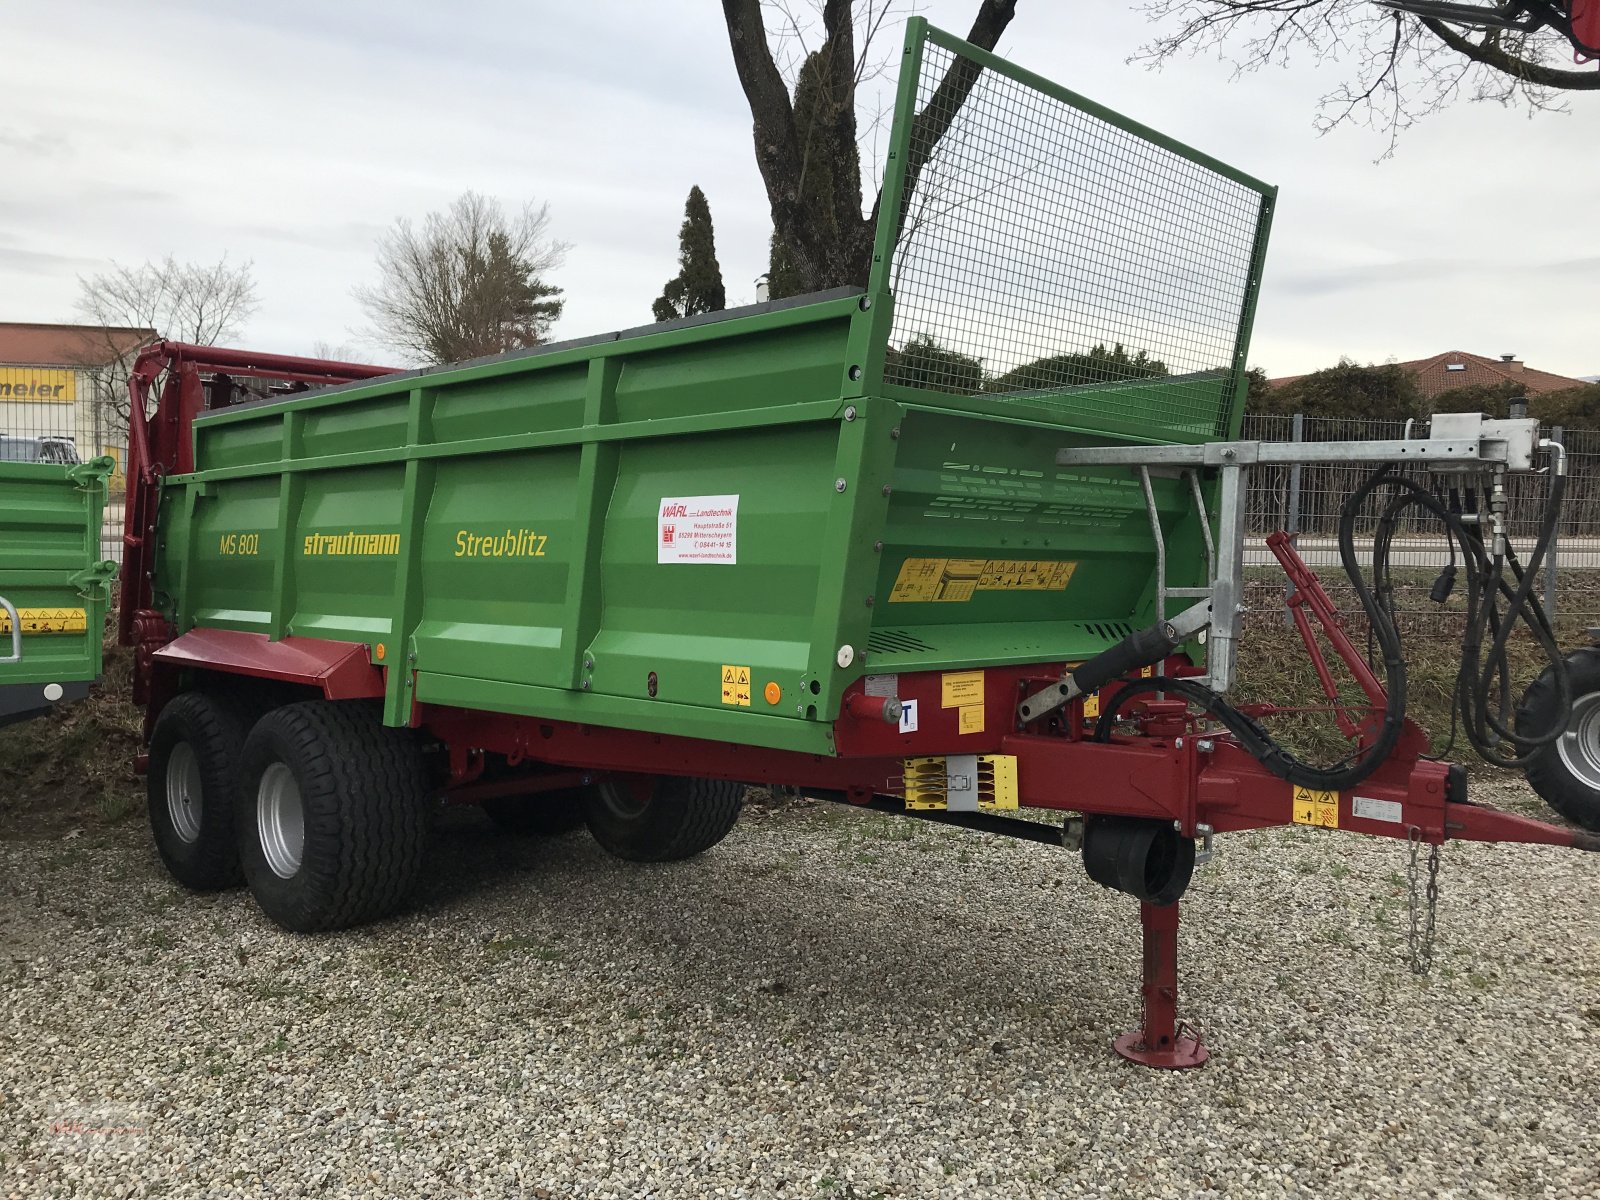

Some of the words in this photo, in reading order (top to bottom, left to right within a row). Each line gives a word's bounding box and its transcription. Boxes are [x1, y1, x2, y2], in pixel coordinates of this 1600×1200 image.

[662, 502, 687, 517] WÄRL
[696, 509, 732, 517] Landtechnik
[219, 534, 237, 555] MS
[238, 534, 259, 555] 801
[303, 531, 401, 555] strautmann
[454, 529, 548, 557] Streublitz
